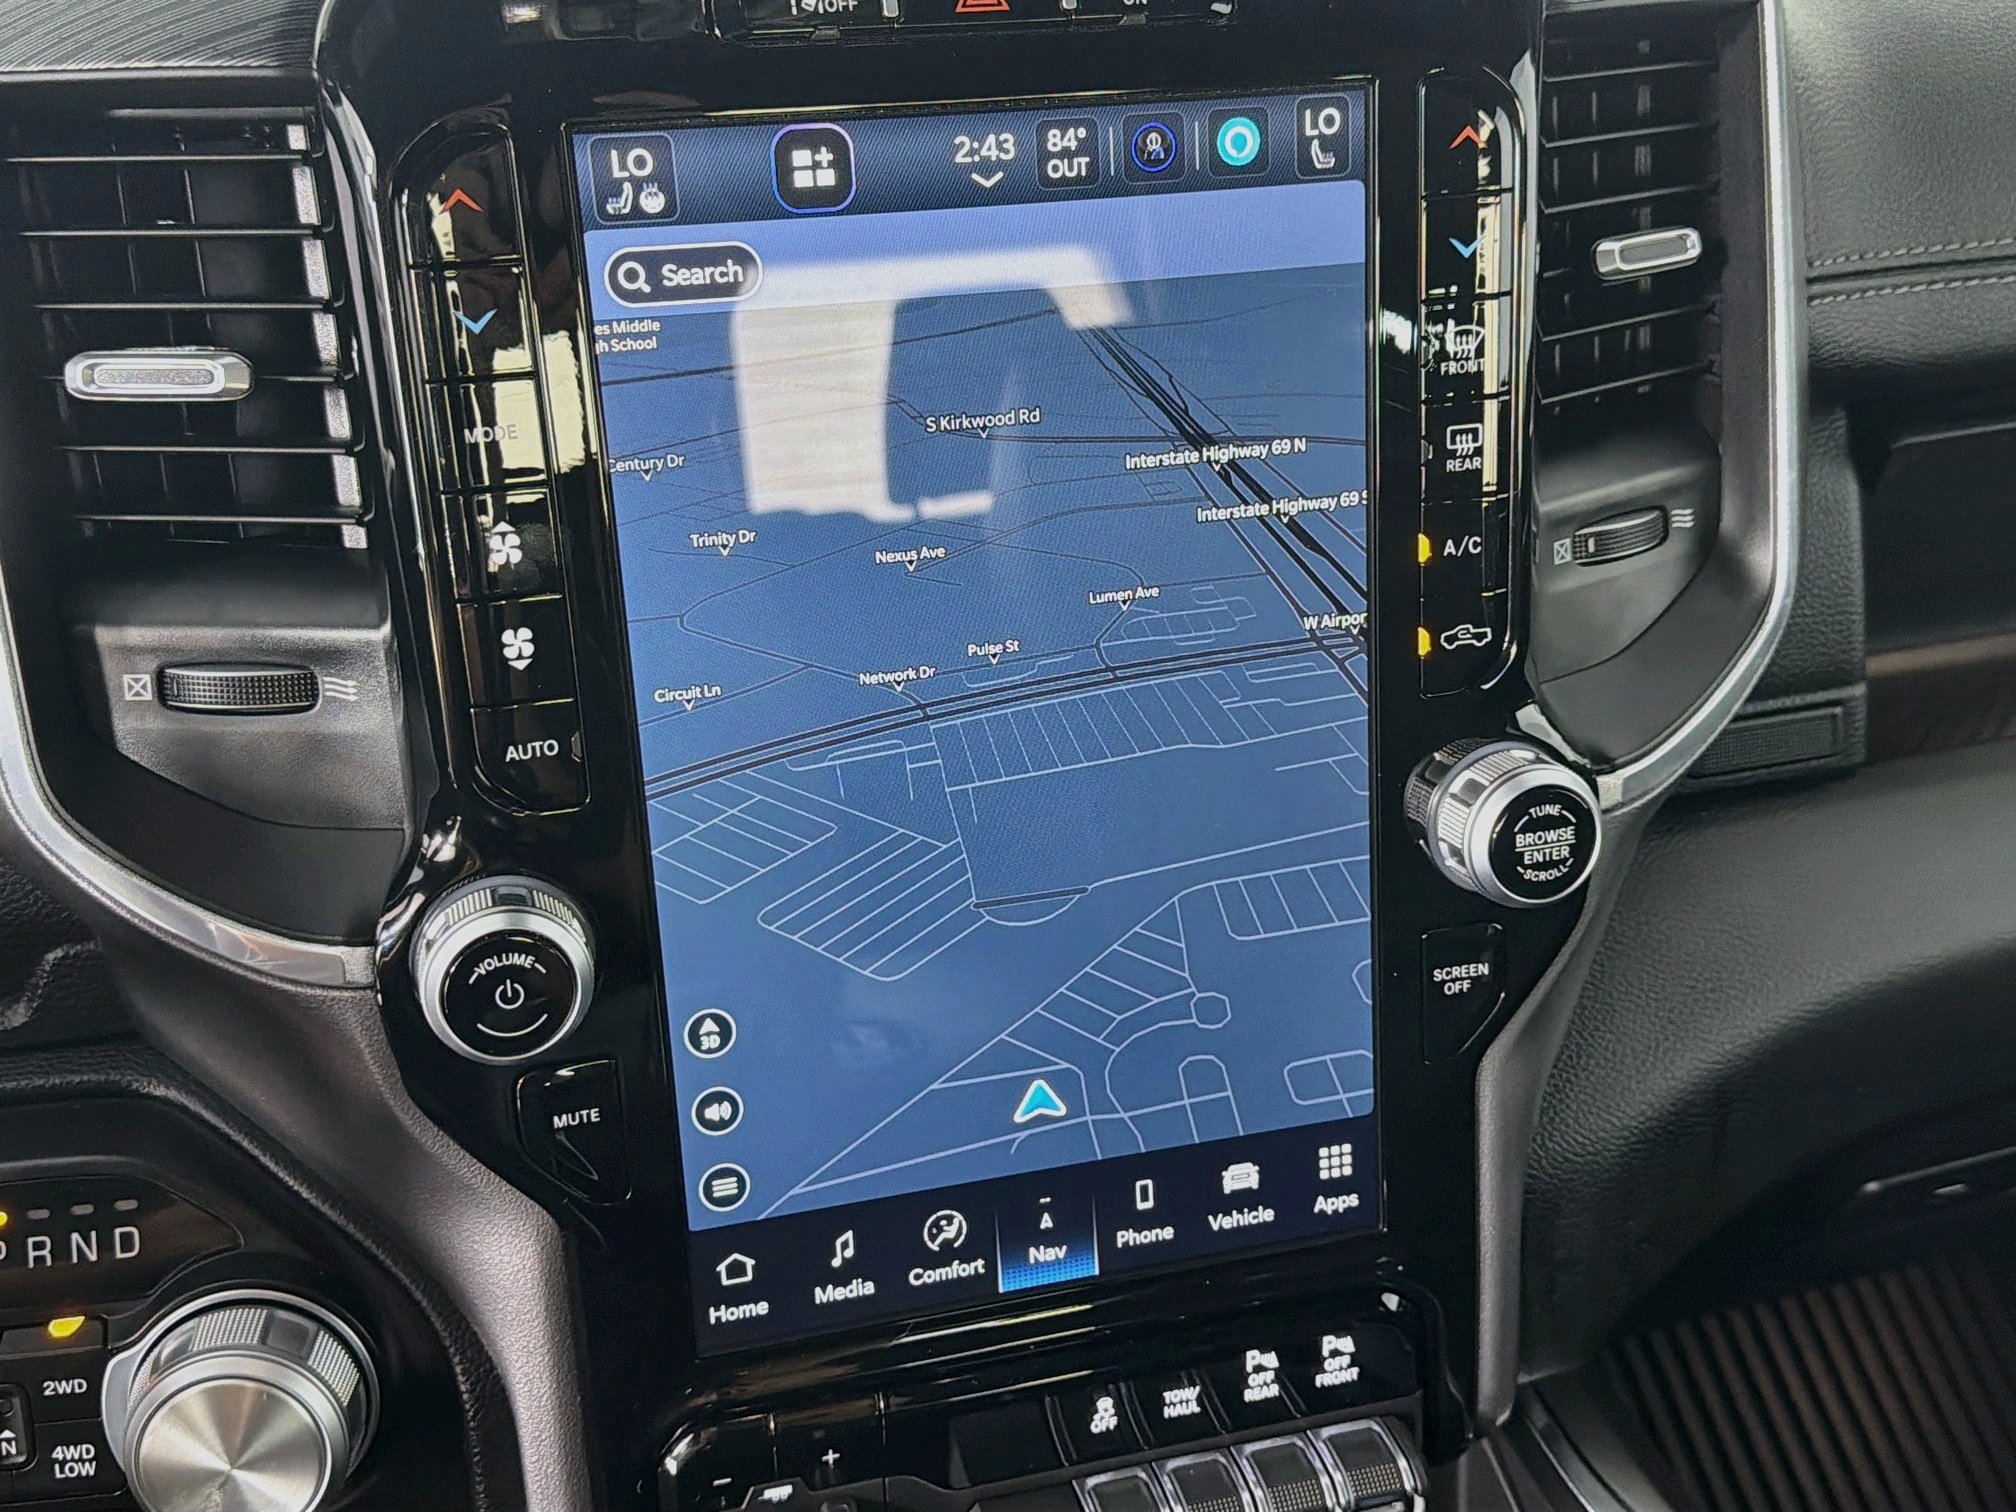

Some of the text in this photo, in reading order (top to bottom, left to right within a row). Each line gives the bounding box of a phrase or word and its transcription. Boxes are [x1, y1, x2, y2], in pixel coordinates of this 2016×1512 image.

[1305, 107, 1341, 136] LO
[954, 133, 1016, 164] 2:43
[1047, 127, 1087, 153] 84°
[610, 148, 654, 178] LO
[1047, 157, 1090, 179] OUT
[661, 259, 744, 287] Search
[612, 319, 661, 334] Middle
[610, 336, 657, 352] School
[1440, 357, 1485, 376] FRONT
[926, 408, 1041, 432] S Kirkwood Rd
[463, 424, 518, 445] MODE
[608, 454, 685, 473] Century Dr
[1125, 438, 1307, 470] Interstate Highway 69 N
[1446, 456, 1482, 472] REAR
[1197, 502, 1270, 522] Interstate
[1272, 496, 1338, 516] Highway
[1340, 490, 1360, 507] 69
[690, 529, 757, 548] Trinity Dr
[1443, 535, 1482, 557] A/C
[875, 546, 946, 564] Nexus Ave
[1089, 586, 1160, 605] Lumen Ave
[1303, 616, 1319, 630] W
[967, 640, 1020, 657] Pulse St
[859, 666, 936, 685] Network Dr
[654, 684, 722, 703] Circuit Ln
[505, 739, 559, 762] AUTO
[1528, 804, 1562, 819] TUNE
[1515, 826, 1576, 847] BROWSE
[1523, 847, 1570, 865] ENTER
[1523, 864, 1569, 882] SCROLL
[473, 952, 536, 976] VOLUME
[1433, 962, 1489, 982] SCREEN
[1444, 980, 1472, 995] OFF
[700, 1034, 721, 1050] 3D
[553, 1107, 601, 1129] MUTE
[1313, 1192, 1359, 1215] Apps
[1208, 1205, 1275, 1231] Vehicle
[1116, 1225, 1175, 1248] Phone
[27, 1235, 52, 1268] R
[70, 1230, 99, 1264] N
[114, 1226, 140, 1259] D
[1029, 1244, 1067, 1263] Nav
[908, 1258, 986, 1286] Comfort
[814, 1278, 875, 1304] Media
[709, 1300, 770, 1325] Home
[1324, 1355, 1351, 1372] OFF
[42, 1378, 88, 1396] 2WD
[1247, 1370, 1275, 1388] OFF
[1315, 1367, 1360, 1388] FRONT
[1162, 1385, 1201, 1405] TOW/
[1244, 1383, 1279, 1403] REAR
[1163, 1402, 1201, 1419] HAUL
[1090, 1415, 1118, 1434] OFF
[1, 1440, 17, 1456] N
[51, 1443, 95, 1461] 4WD
[54, 1460, 97, 1479] LOW
